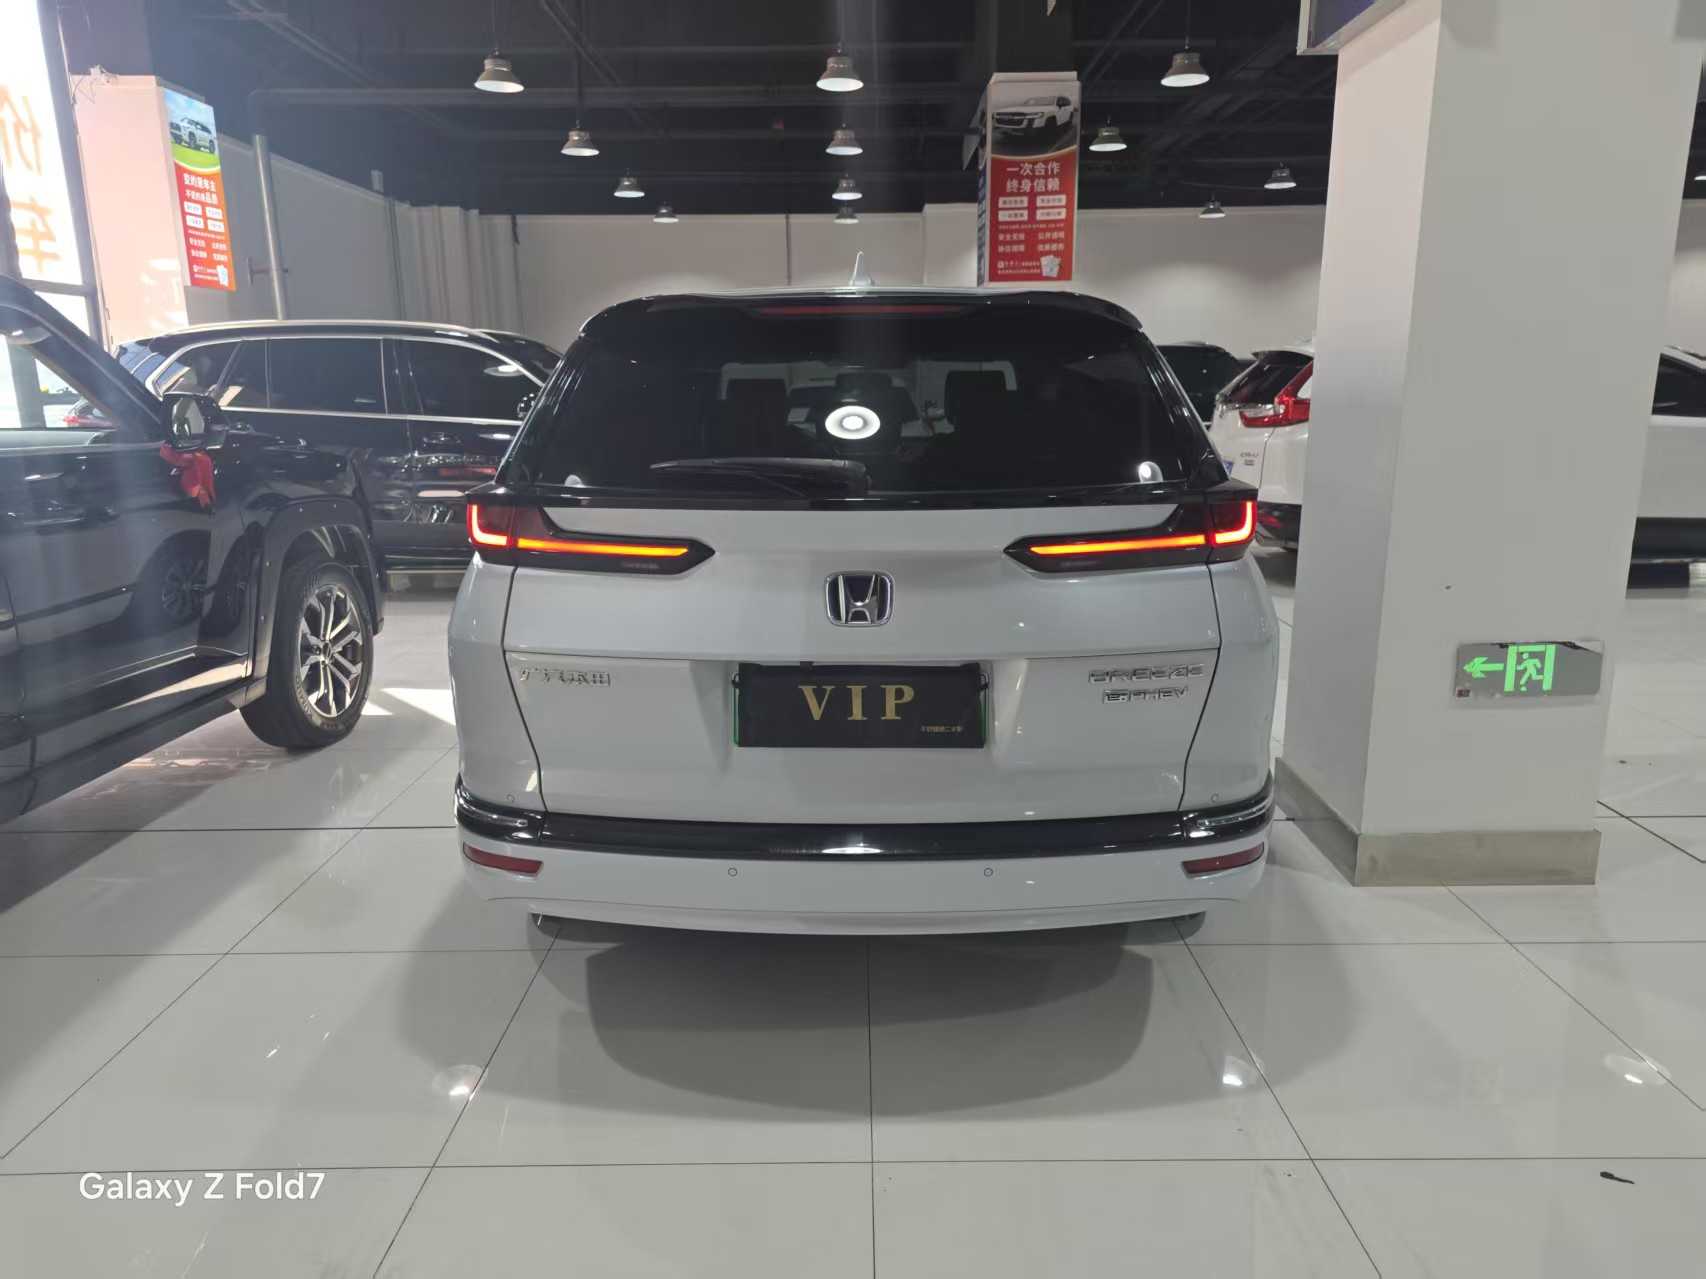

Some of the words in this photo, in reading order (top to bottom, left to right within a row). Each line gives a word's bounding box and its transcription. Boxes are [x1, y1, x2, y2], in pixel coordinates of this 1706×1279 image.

[1006, 161, 1061, 176] 一次合作
[1006, 178, 1060, 193] 终身信赖
[798, 684, 915, 721] VIP
